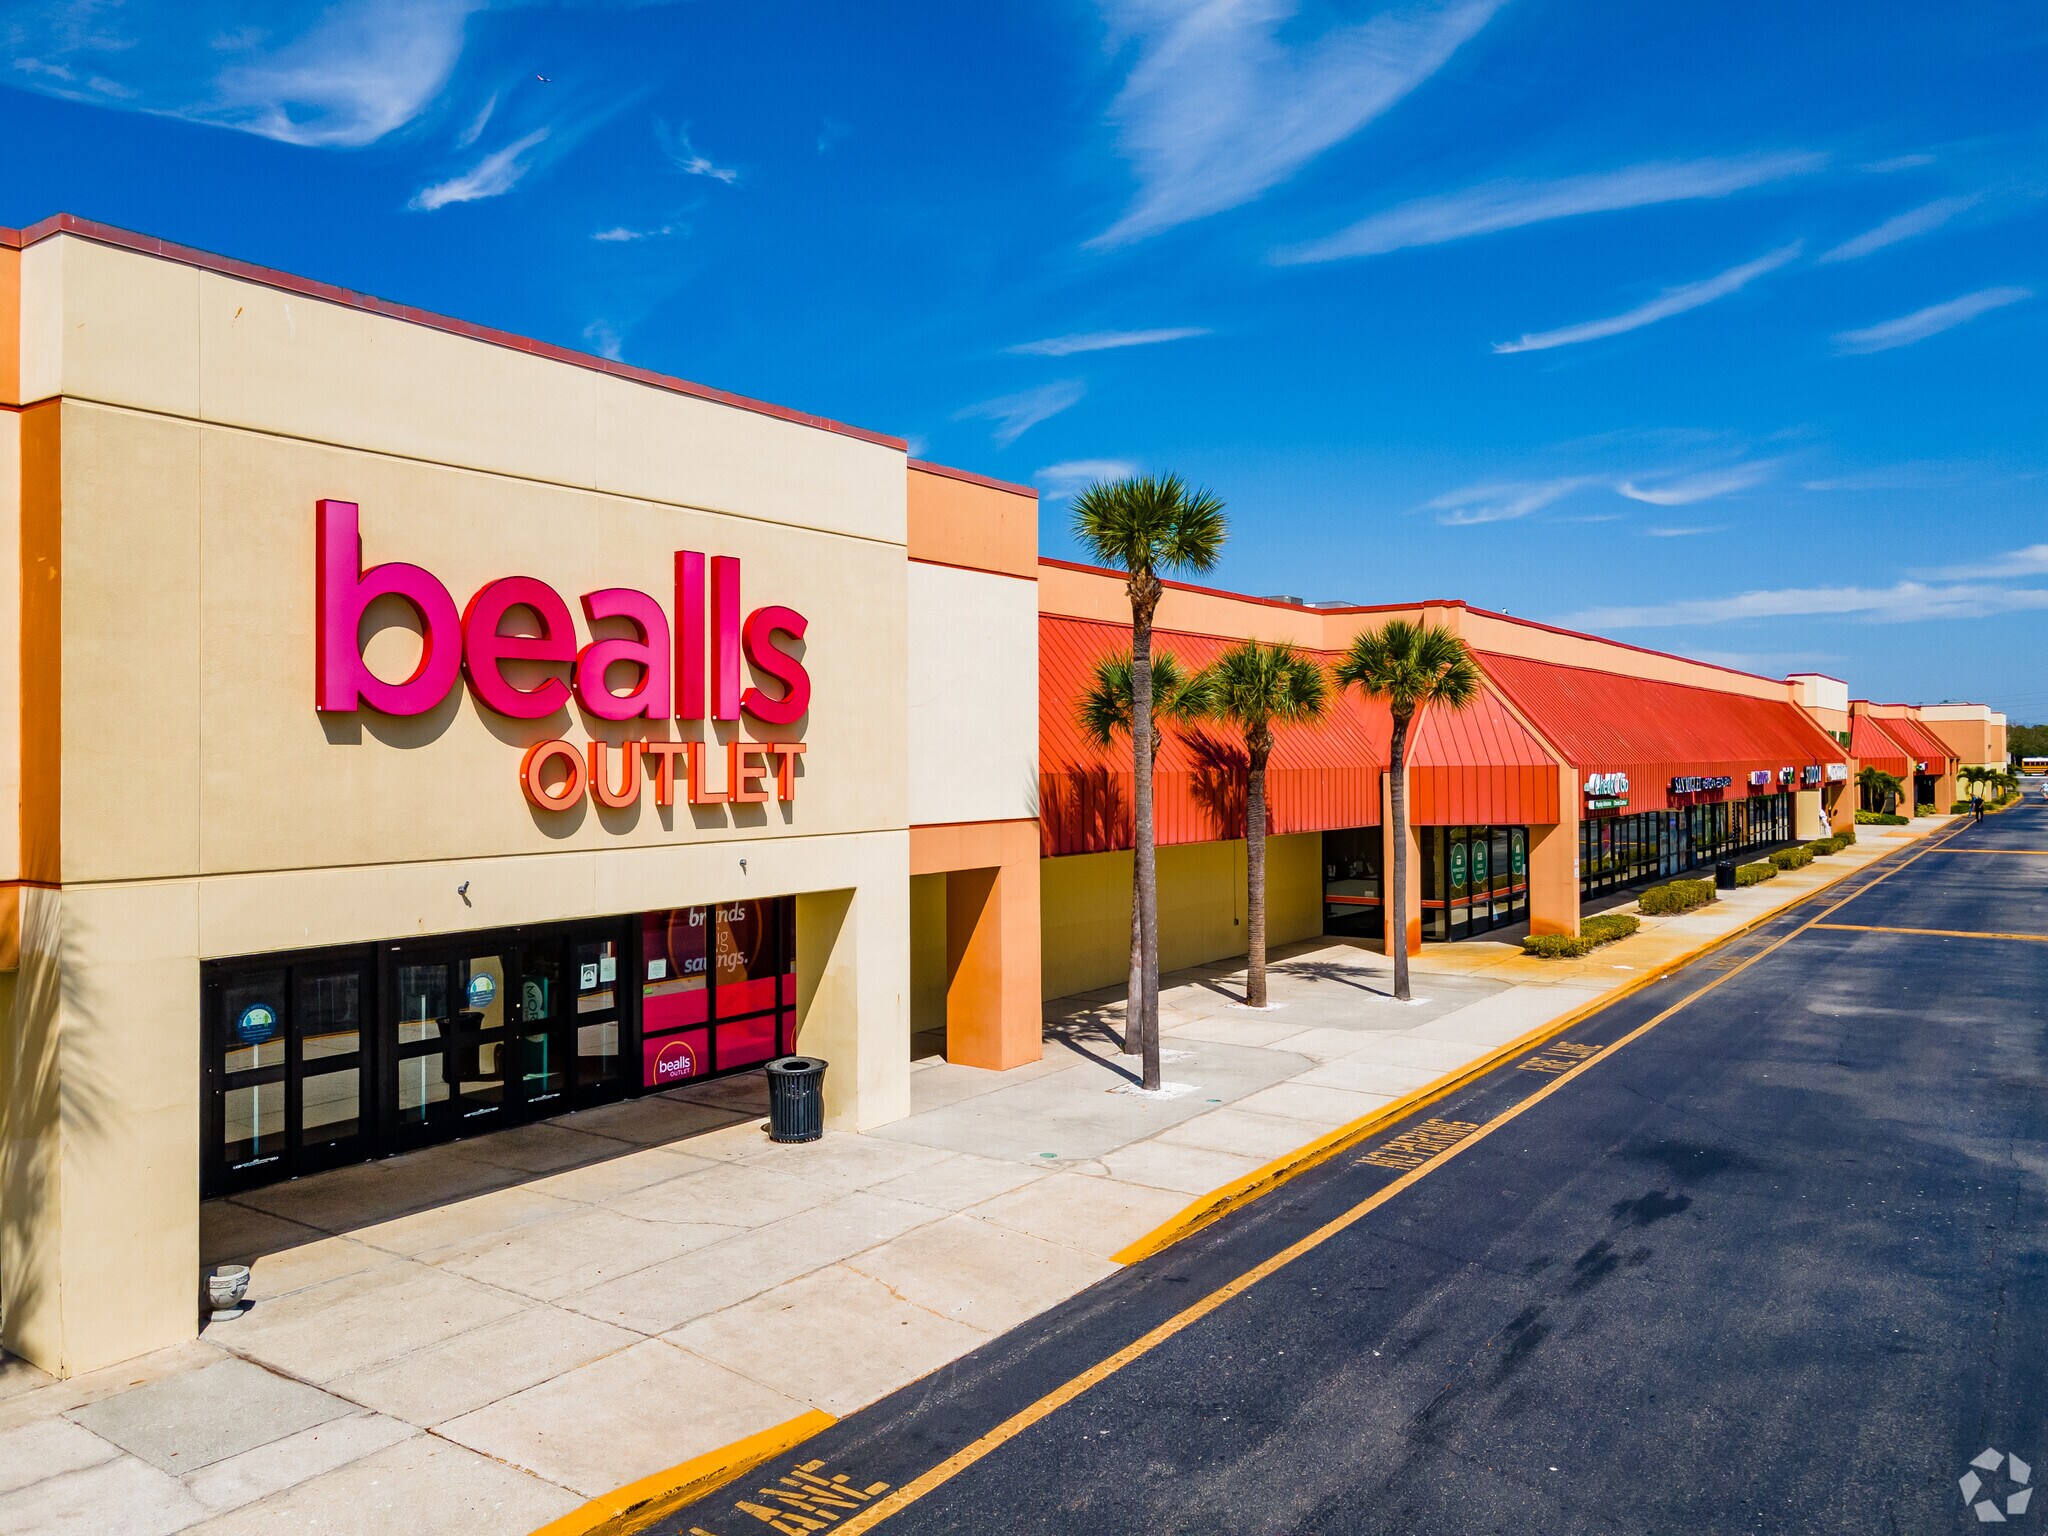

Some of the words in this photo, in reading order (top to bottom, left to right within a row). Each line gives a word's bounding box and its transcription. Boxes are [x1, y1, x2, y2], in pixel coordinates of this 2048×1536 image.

[316, 498, 811, 724] bealls
[520, 740, 807, 812] OUTLET
[688, 902, 746, 927] brnds
[716, 927, 729, 953] ig
[659, 1056, 690, 1074] bealls
[669, 1067, 690, 1077] OUTLET
